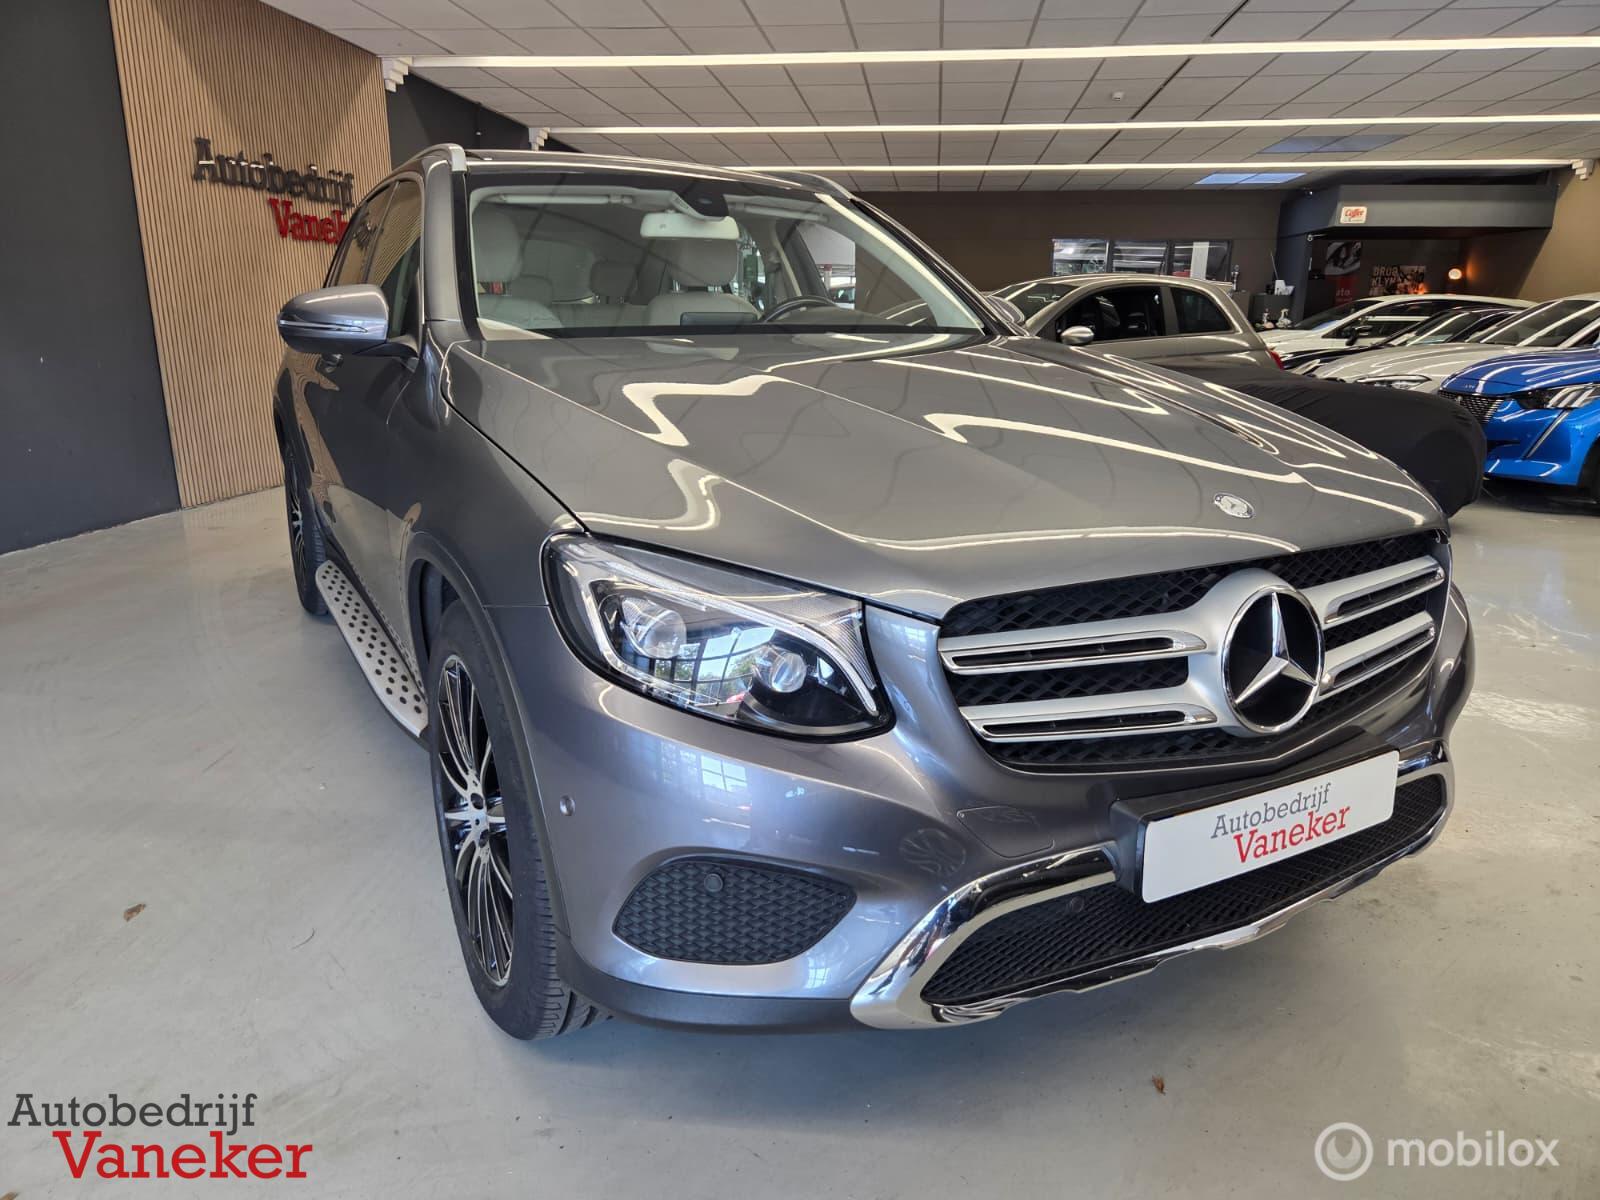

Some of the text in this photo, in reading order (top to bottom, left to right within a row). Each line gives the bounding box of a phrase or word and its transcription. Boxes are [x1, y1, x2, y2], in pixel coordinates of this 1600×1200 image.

[193, 136, 355, 215] Autobedrijf
[267, 198, 350, 245] Vanek
[1211, 782, 1331, 839] Autobedrijf
[1233, 806, 1351, 863] Vaneker
